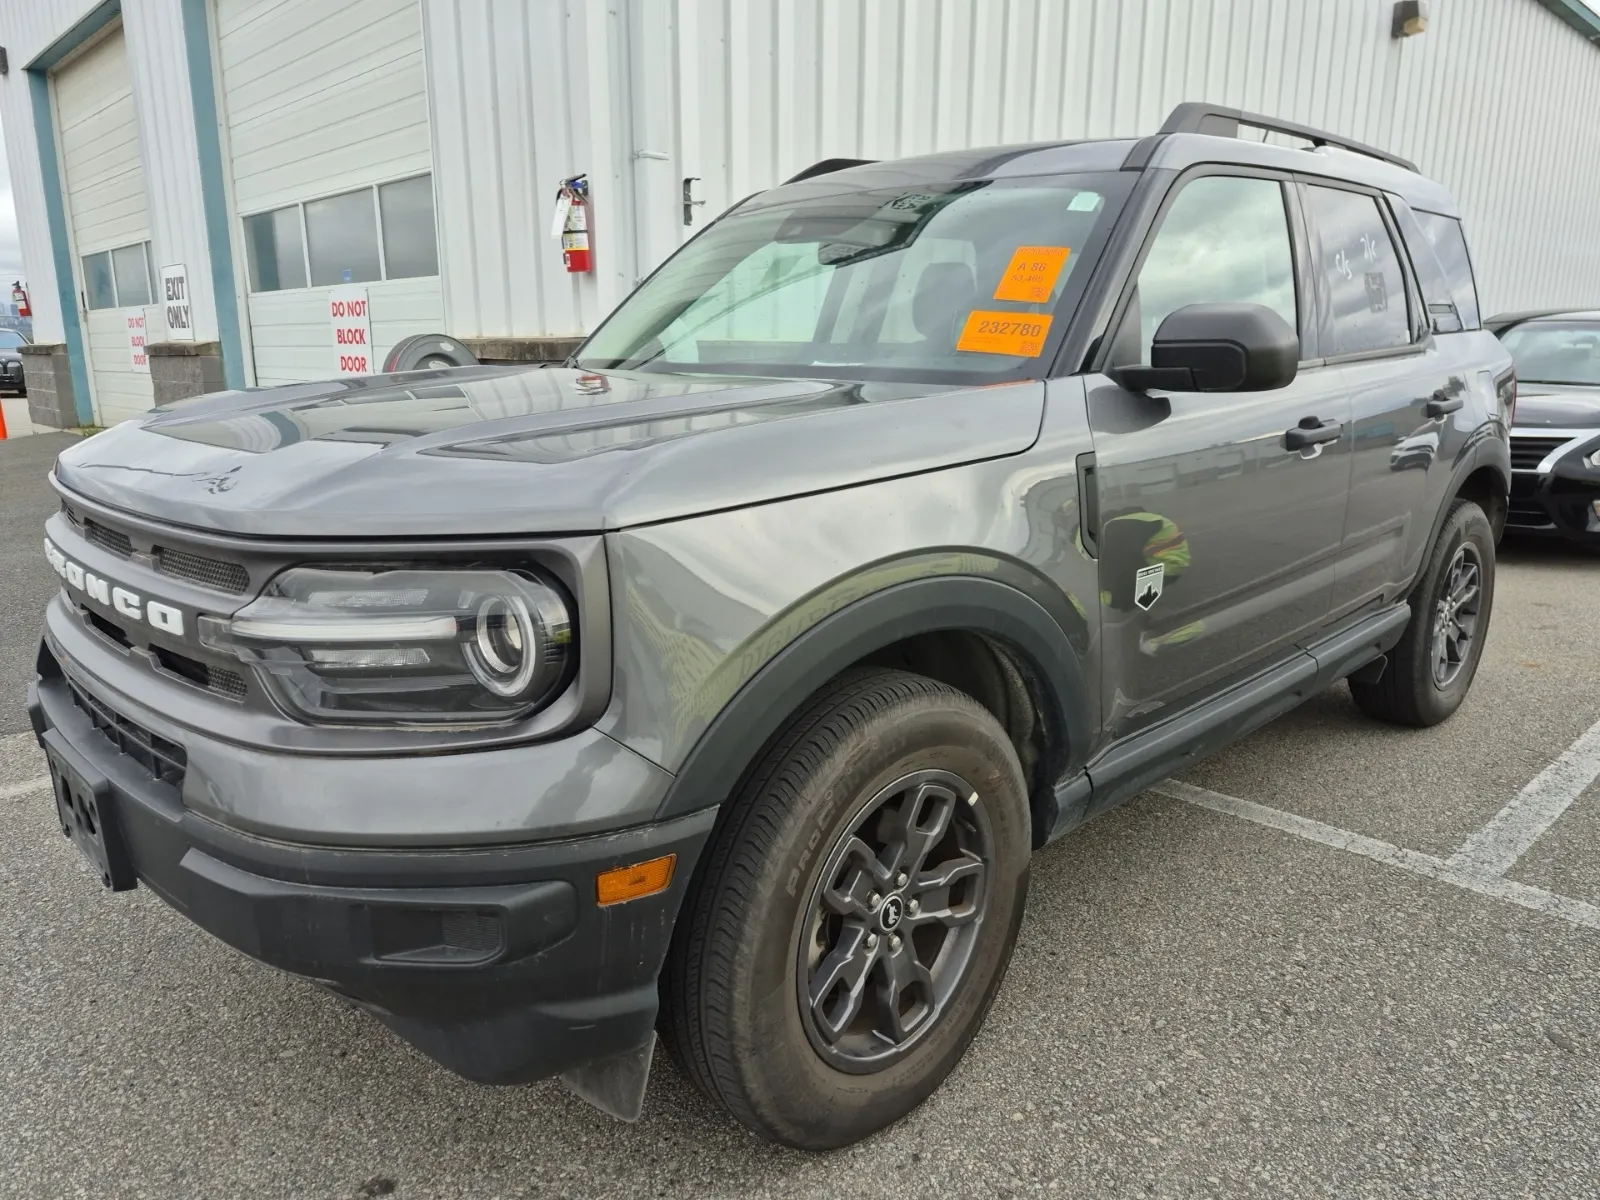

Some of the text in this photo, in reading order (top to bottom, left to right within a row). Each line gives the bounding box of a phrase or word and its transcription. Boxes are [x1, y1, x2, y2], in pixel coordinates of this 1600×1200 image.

[1017, 262, 1047, 272] A 86
[165, 276, 185, 301] EXIT
[332, 300, 367, 317] DO NOT
[127, 317, 145, 329] DO NOT
[166, 305, 190, 329] ONLY
[336, 328, 366, 345] BLOCK
[978, 321, 1042, 337] 232780
[131, 335, 146, 347] BLOCK
[133, 354, 147, 365] DOOR
[340, 355, 367, 373] DOOR
